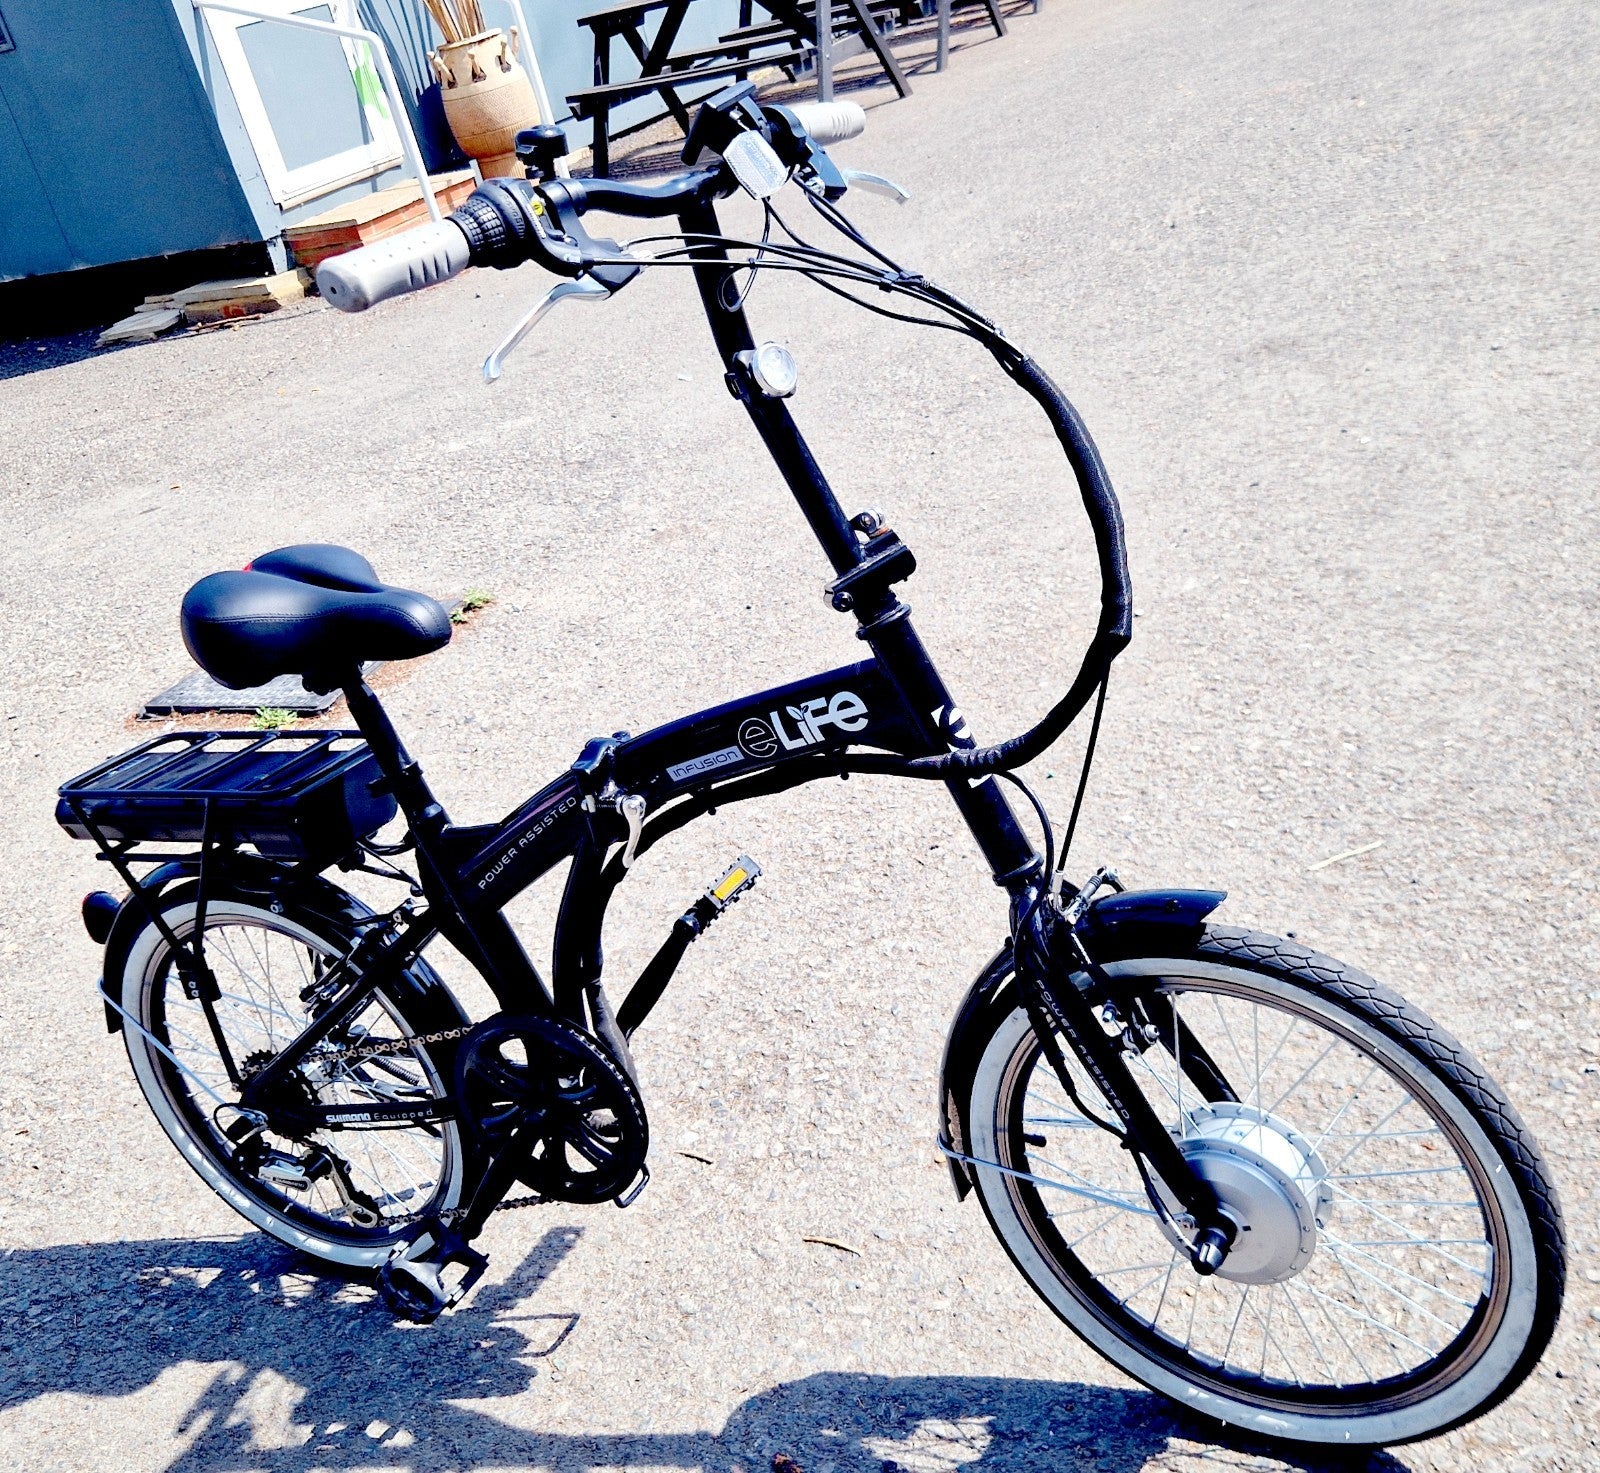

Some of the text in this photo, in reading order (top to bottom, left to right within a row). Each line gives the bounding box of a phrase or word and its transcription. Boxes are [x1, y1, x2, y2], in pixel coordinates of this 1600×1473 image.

[672, 750, 739, 778] INFUSION
[478, 796, 577, 889] POWER ASSISTED
[1036, 979, 1130, 1120] POWER ASSISTED
[325, 1108, 433, 1123] SHIMANO Equipped
